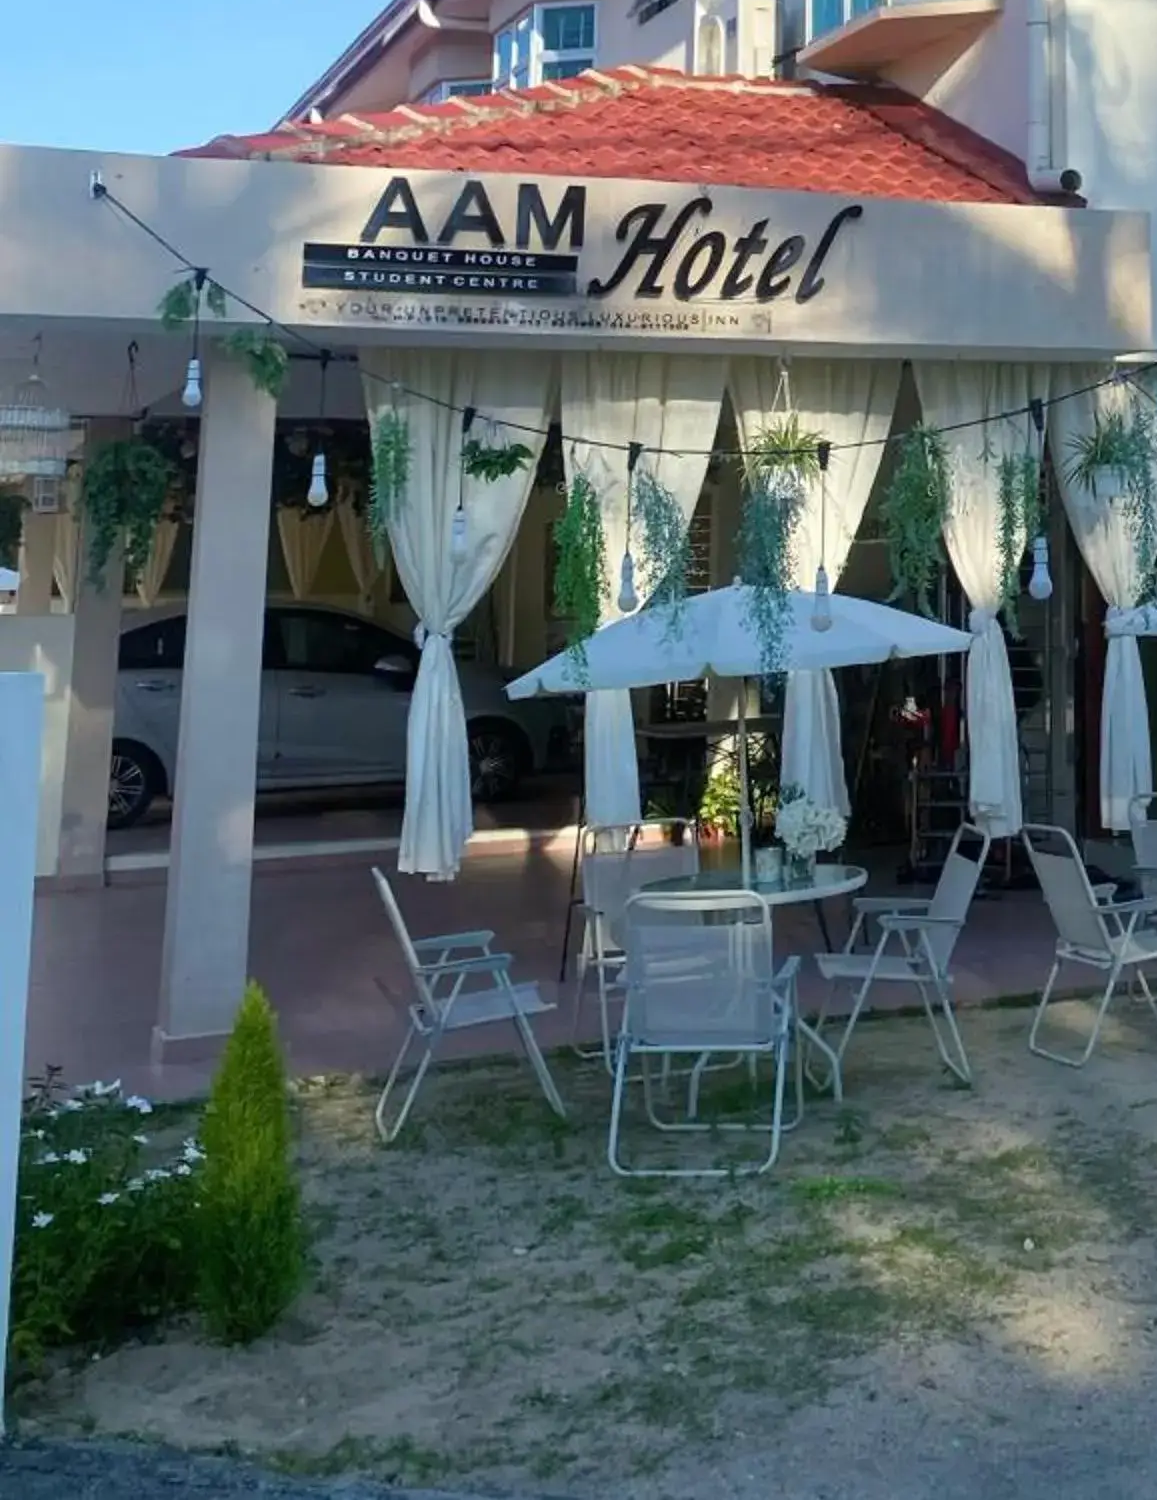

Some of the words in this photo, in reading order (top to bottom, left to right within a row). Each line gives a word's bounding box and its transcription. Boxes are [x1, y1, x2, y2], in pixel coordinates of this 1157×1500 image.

[360, 176, 587, 250] AAM
[587, 197, 863, 304] Hotel
[347, 248, 454, 263] BANQUET
[464, 252, 537, 268] HOUSE
[344, 270, 445, 286] STUDENT
[453, 275, 539, 290] CENTRE
[708, 314, 740, 326] INN
